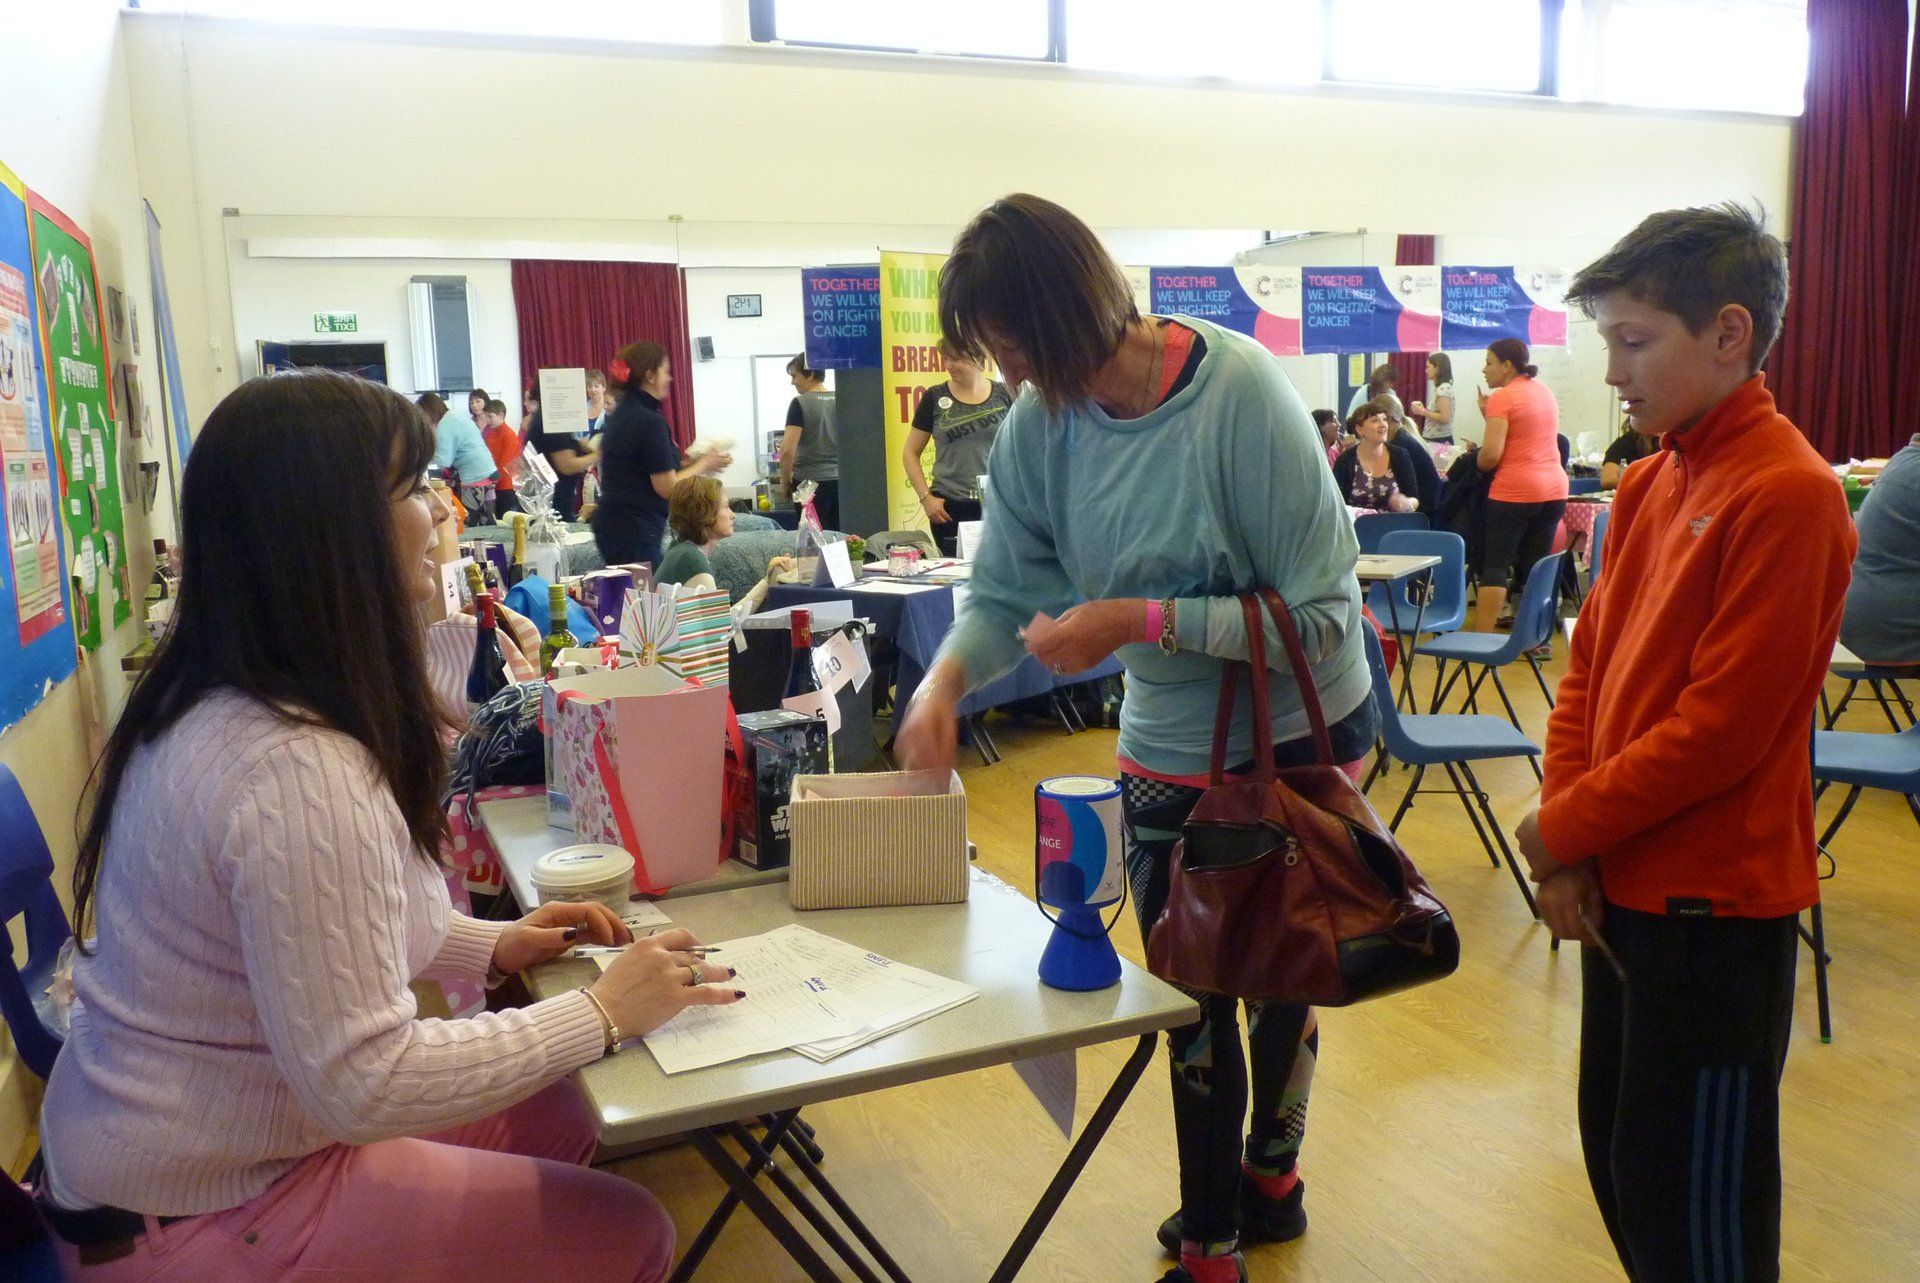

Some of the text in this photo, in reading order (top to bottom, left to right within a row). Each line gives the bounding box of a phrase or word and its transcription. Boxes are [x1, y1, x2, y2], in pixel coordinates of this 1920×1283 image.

[1156, 276, 1217, 288] TOGETHER
[1308, 275, 1363, 287] TOGETHER
[1446, 273, 1498, 286] TOGETHER
[1156, 289, 1231, 303] WE WILL KEEP
[1308, 288, 1376, 300] WE WILL KEEP
[1446, 287, 1510, 298] WE WILL KEEP
[811, 294, 833, 307] WE
[835, 294, 867, 306] WILL
[1446, 300, 1464, 311] ON
[1157, 304, 1231, 316] ON FIGHTING
[1308, 301, 1376, 314] ON FIGHTING
[812, 309, 834, 322] ON
[890, 310, 922, 334] YOU
[1308, 316, 1351, 327] CANCER
[813, 324, 868, 338] CANCER
[945, 421, 976, 444] JUST
